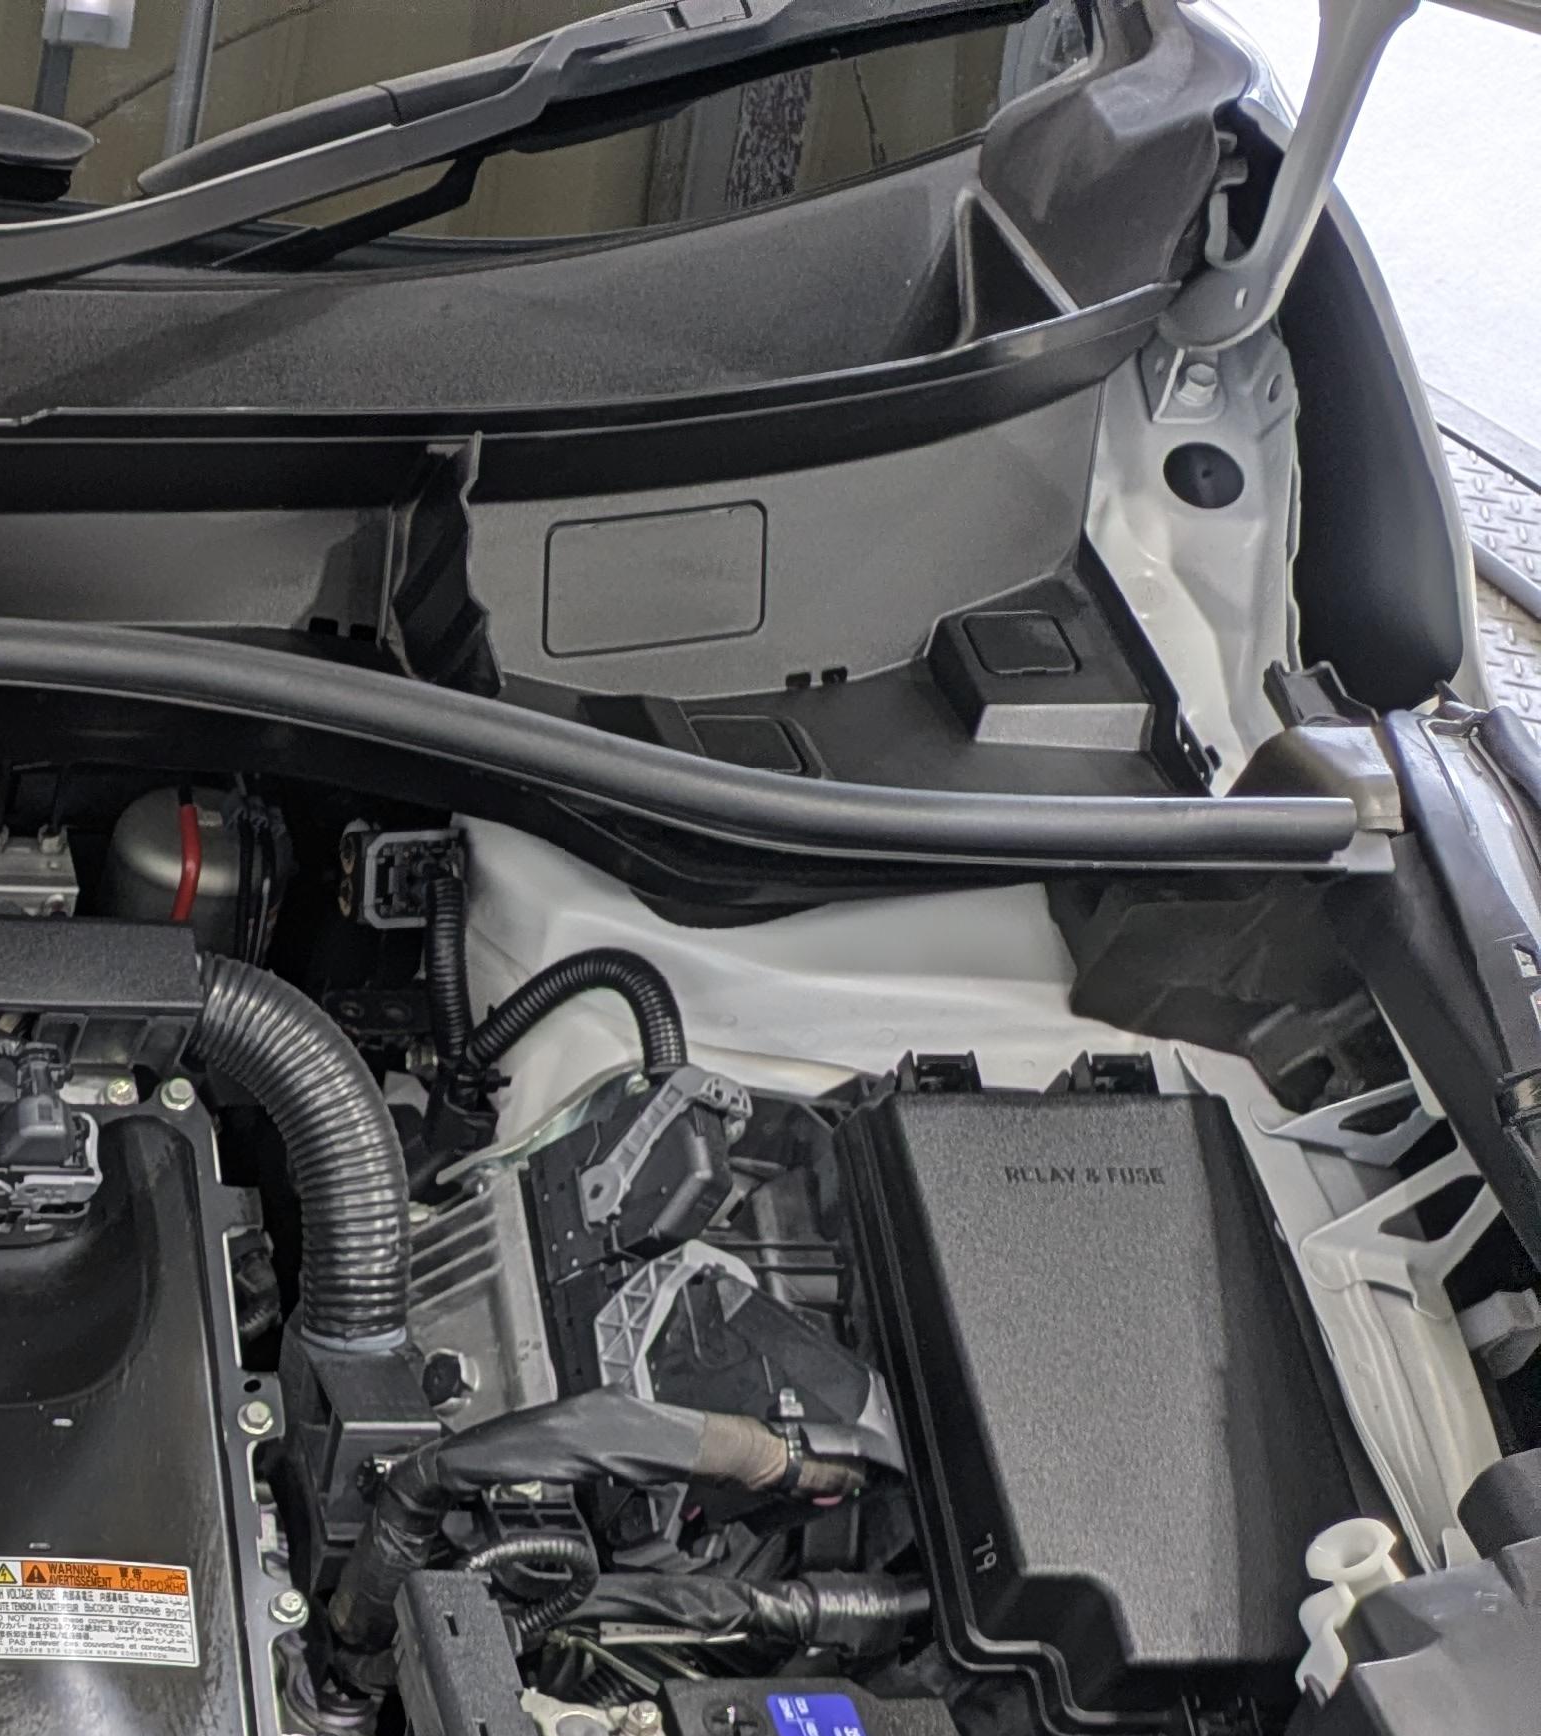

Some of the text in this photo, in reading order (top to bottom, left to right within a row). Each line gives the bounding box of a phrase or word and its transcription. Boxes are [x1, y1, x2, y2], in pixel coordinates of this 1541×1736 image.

[1004, 1165, 1075, 1184] RELAY
[1106, 1166, 1166, 1185] FUSE
[48, 1563, 99, 1577] WARNING
[49, 1575, 112, 1588] AVERTISSEMENT
[120, 1577, 187, 1594] ОСТОРОЖНО
[7, 1588, 34, 1599] VOLTAGE
[37, 1589, 56, 1600] INSIDE
[11, 1602, 37, 1611] TENSION
